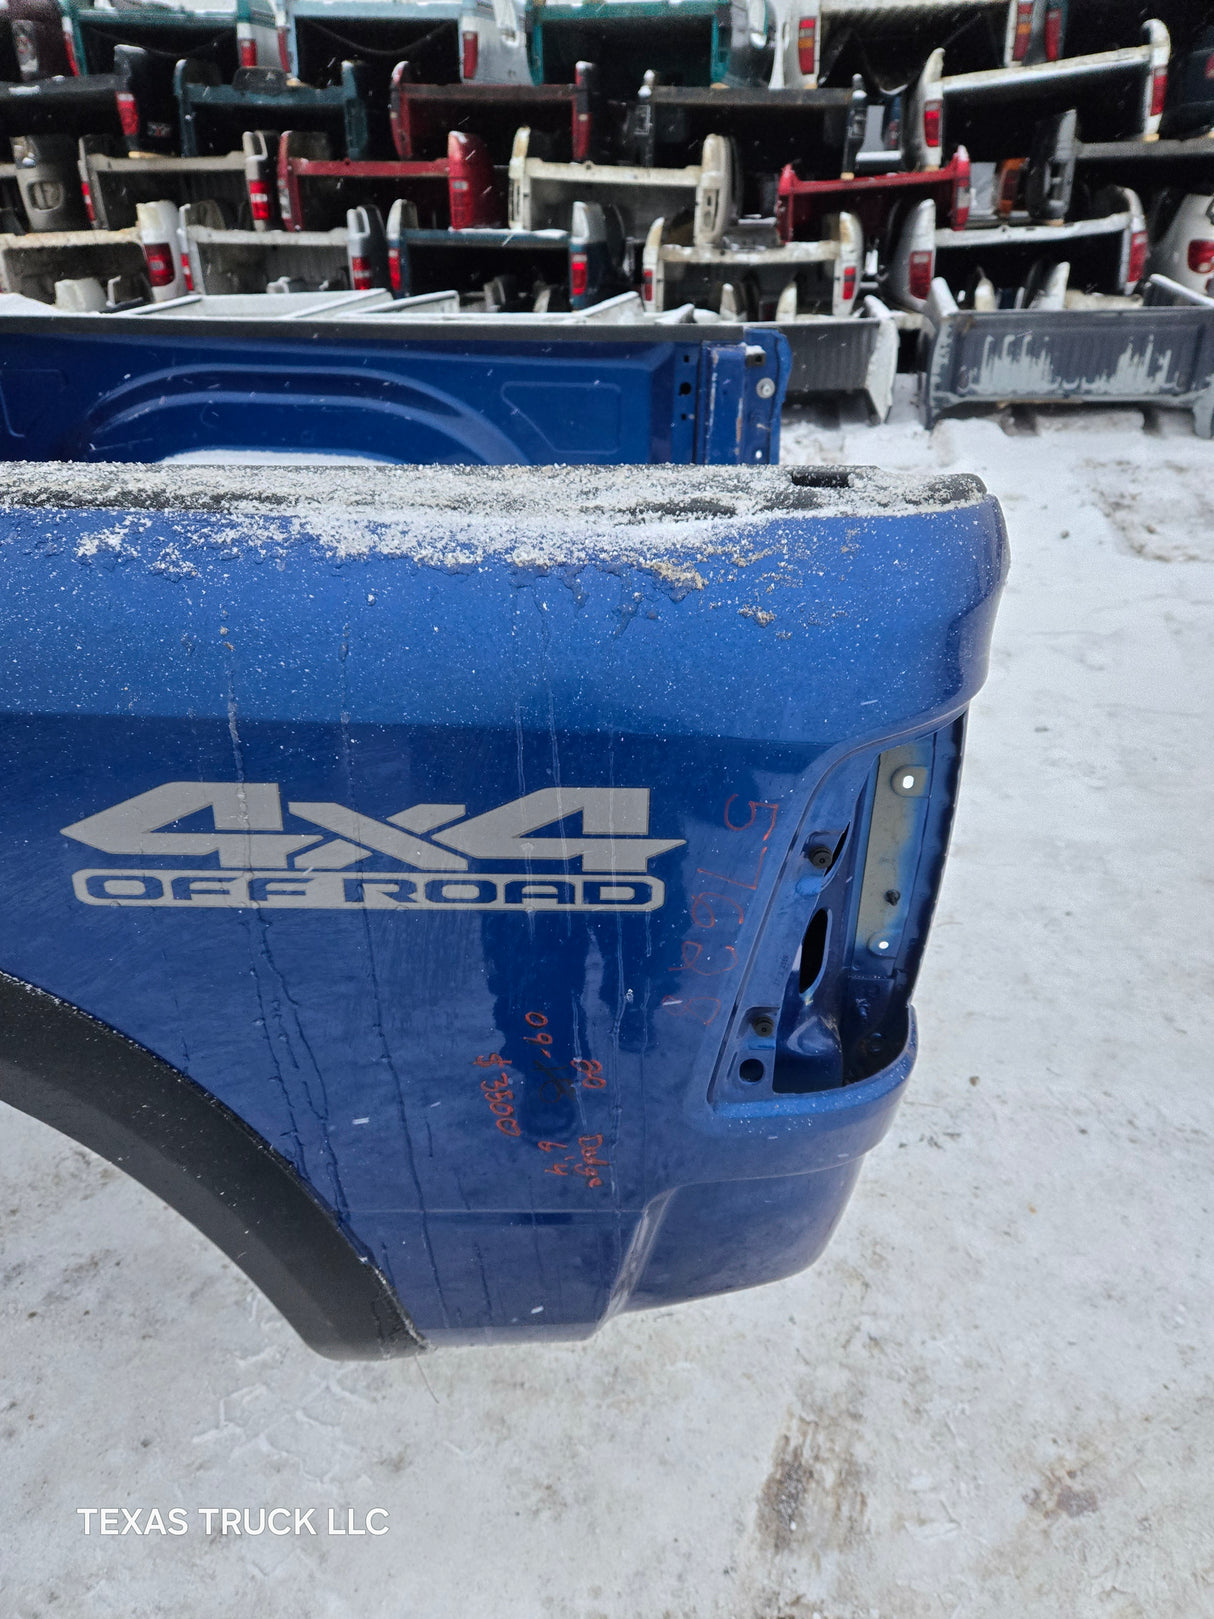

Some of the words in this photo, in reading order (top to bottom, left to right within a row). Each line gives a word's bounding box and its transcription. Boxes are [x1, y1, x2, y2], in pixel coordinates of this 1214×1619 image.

[84, 873, 314, 901] OFF
[344, 876, 652, 906] ROAD
[574, 1134, 610, 1189] Dodge
